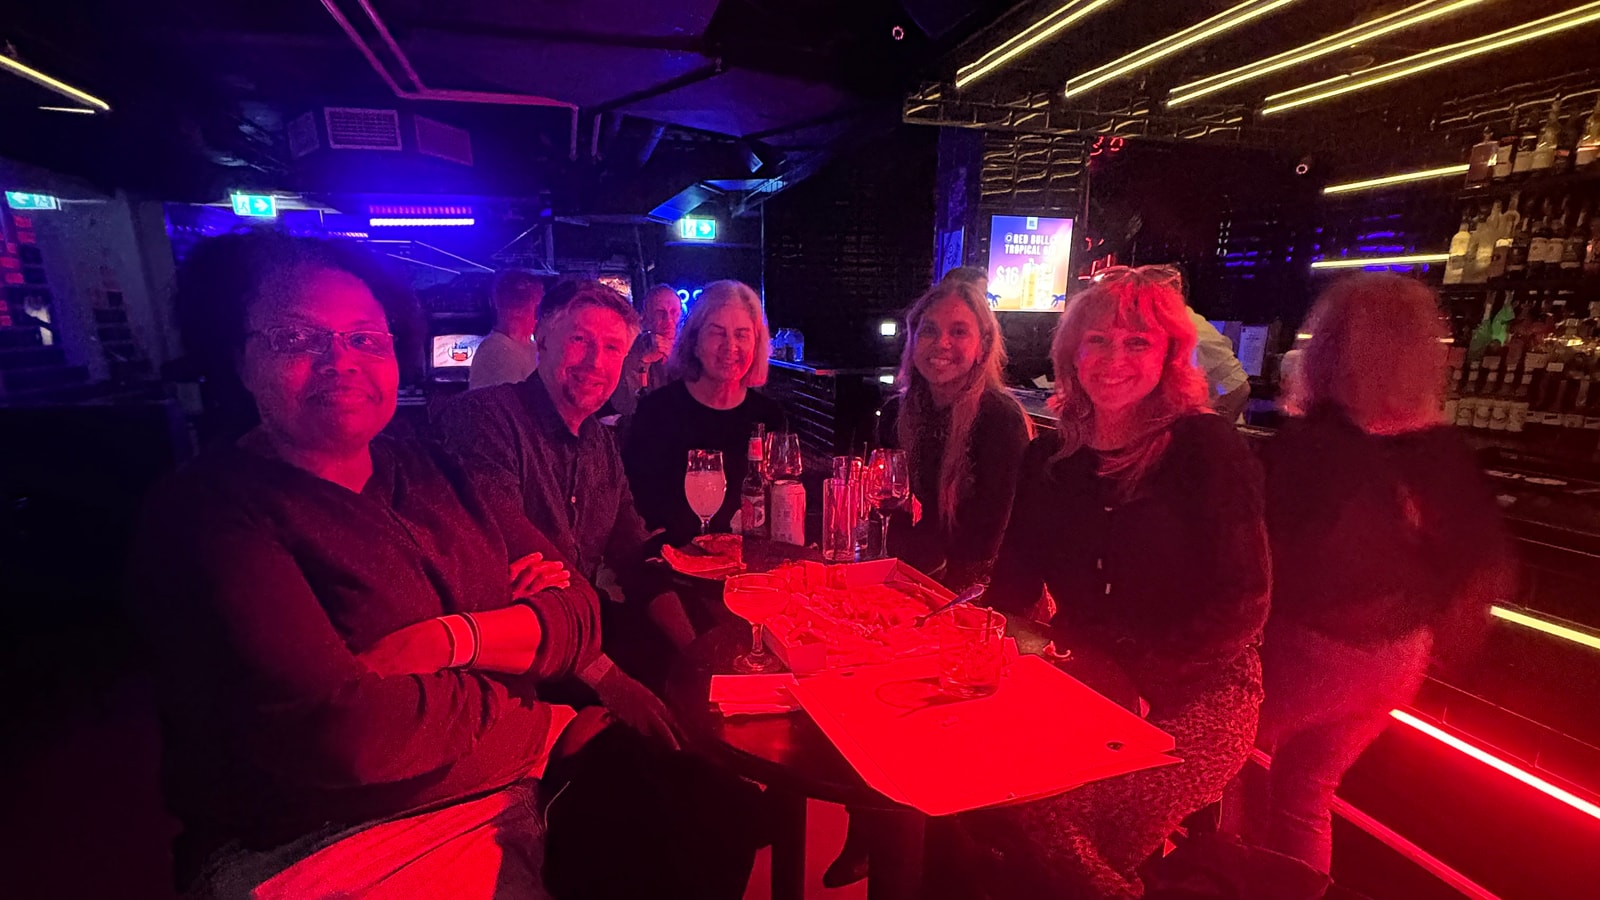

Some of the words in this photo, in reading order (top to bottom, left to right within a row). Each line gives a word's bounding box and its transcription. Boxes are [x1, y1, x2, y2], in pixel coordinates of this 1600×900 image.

[1014, 234, 1028, 244] RED
[1031, 235, 1049, 245] BULL
[1005, 244, 1040, 255] TROPICAL
